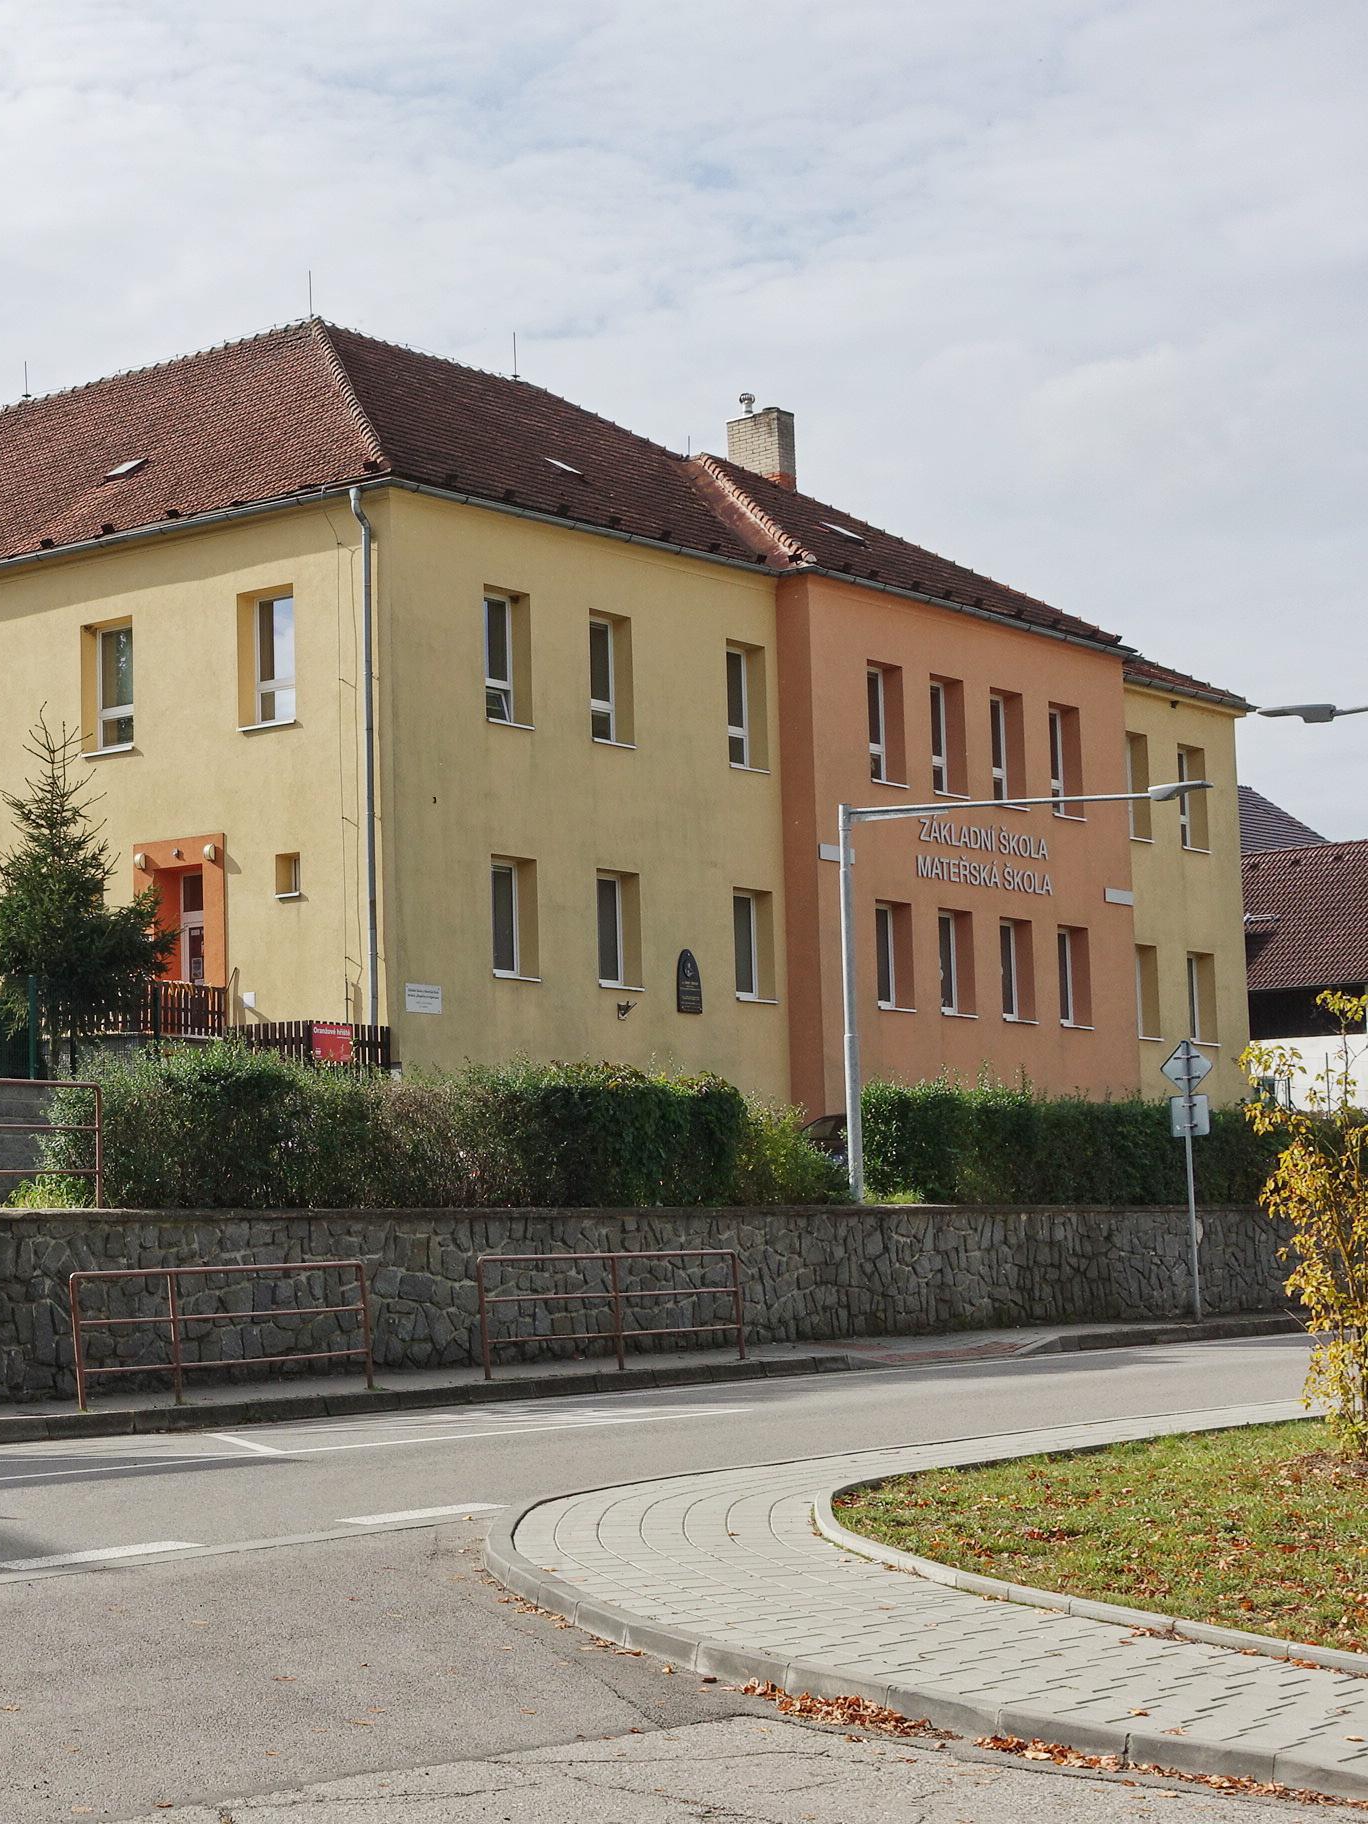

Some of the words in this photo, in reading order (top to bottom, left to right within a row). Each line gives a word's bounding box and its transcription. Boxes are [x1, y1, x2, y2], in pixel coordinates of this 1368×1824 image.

[919, 815, 996, 852] ZÁKLADNÍ
[999, 826, 1049, 860] ŠKOLA
[916, 854, 1001, 888] MATEŘSKÁ
[1003, 863, 1053, 896] ŠKOLA
